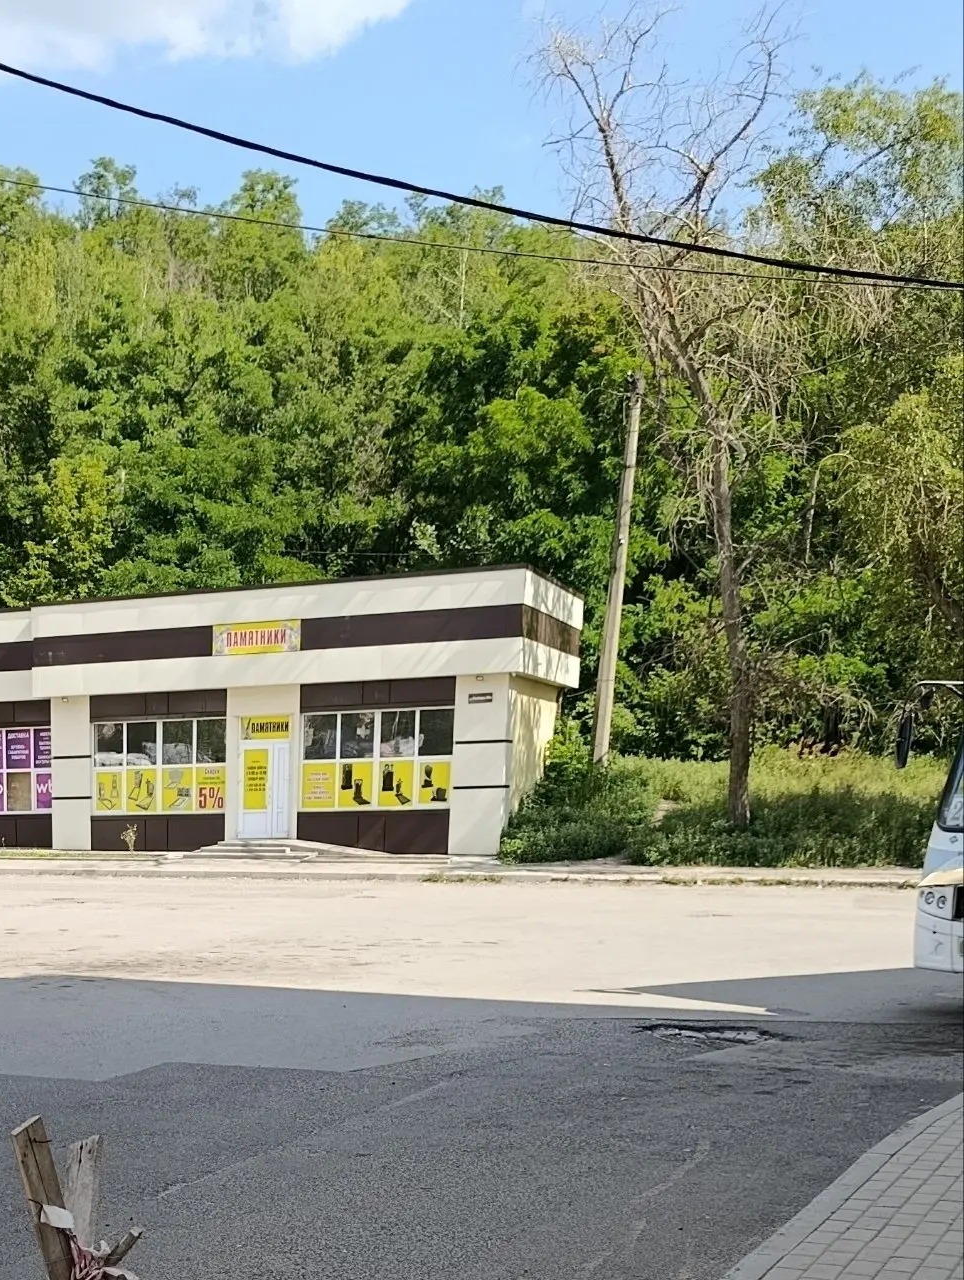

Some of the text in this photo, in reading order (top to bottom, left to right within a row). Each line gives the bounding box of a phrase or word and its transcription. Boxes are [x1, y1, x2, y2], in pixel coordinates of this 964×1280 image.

[226, 628, 287, 648] ПАМЯТНИКИ
[251, 721, 289, 733] ПАМЯТНИКИ
[198, 787, 224, 809] 5%
